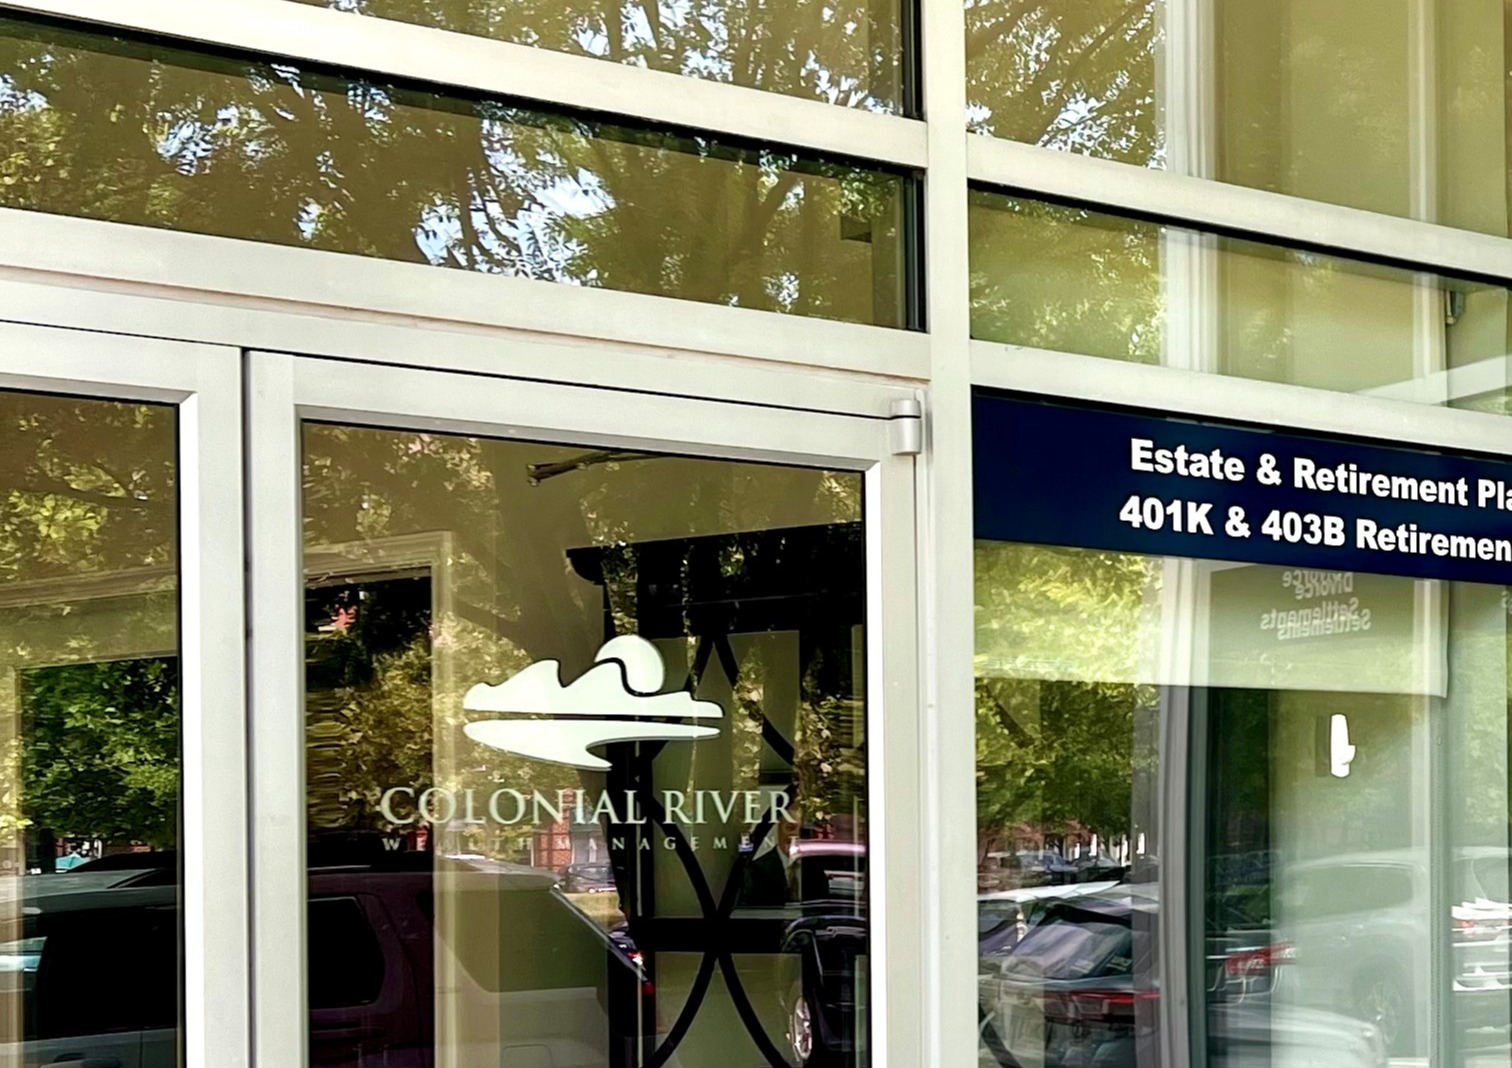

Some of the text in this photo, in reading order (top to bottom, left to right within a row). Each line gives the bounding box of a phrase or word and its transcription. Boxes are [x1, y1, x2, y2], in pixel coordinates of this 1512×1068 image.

[1130, 437, 1245, 481] Estate
[1256, 453, 1282, 486] &
[1293, 457, 1468, 506] Retirement
[1119, 495, 1214, 535] 401K
[1224, 505, 1251, 538] &
[1261, 509, 1345, 546] 403B
[379, 787, 797, 826] COLONIAL RIVER
